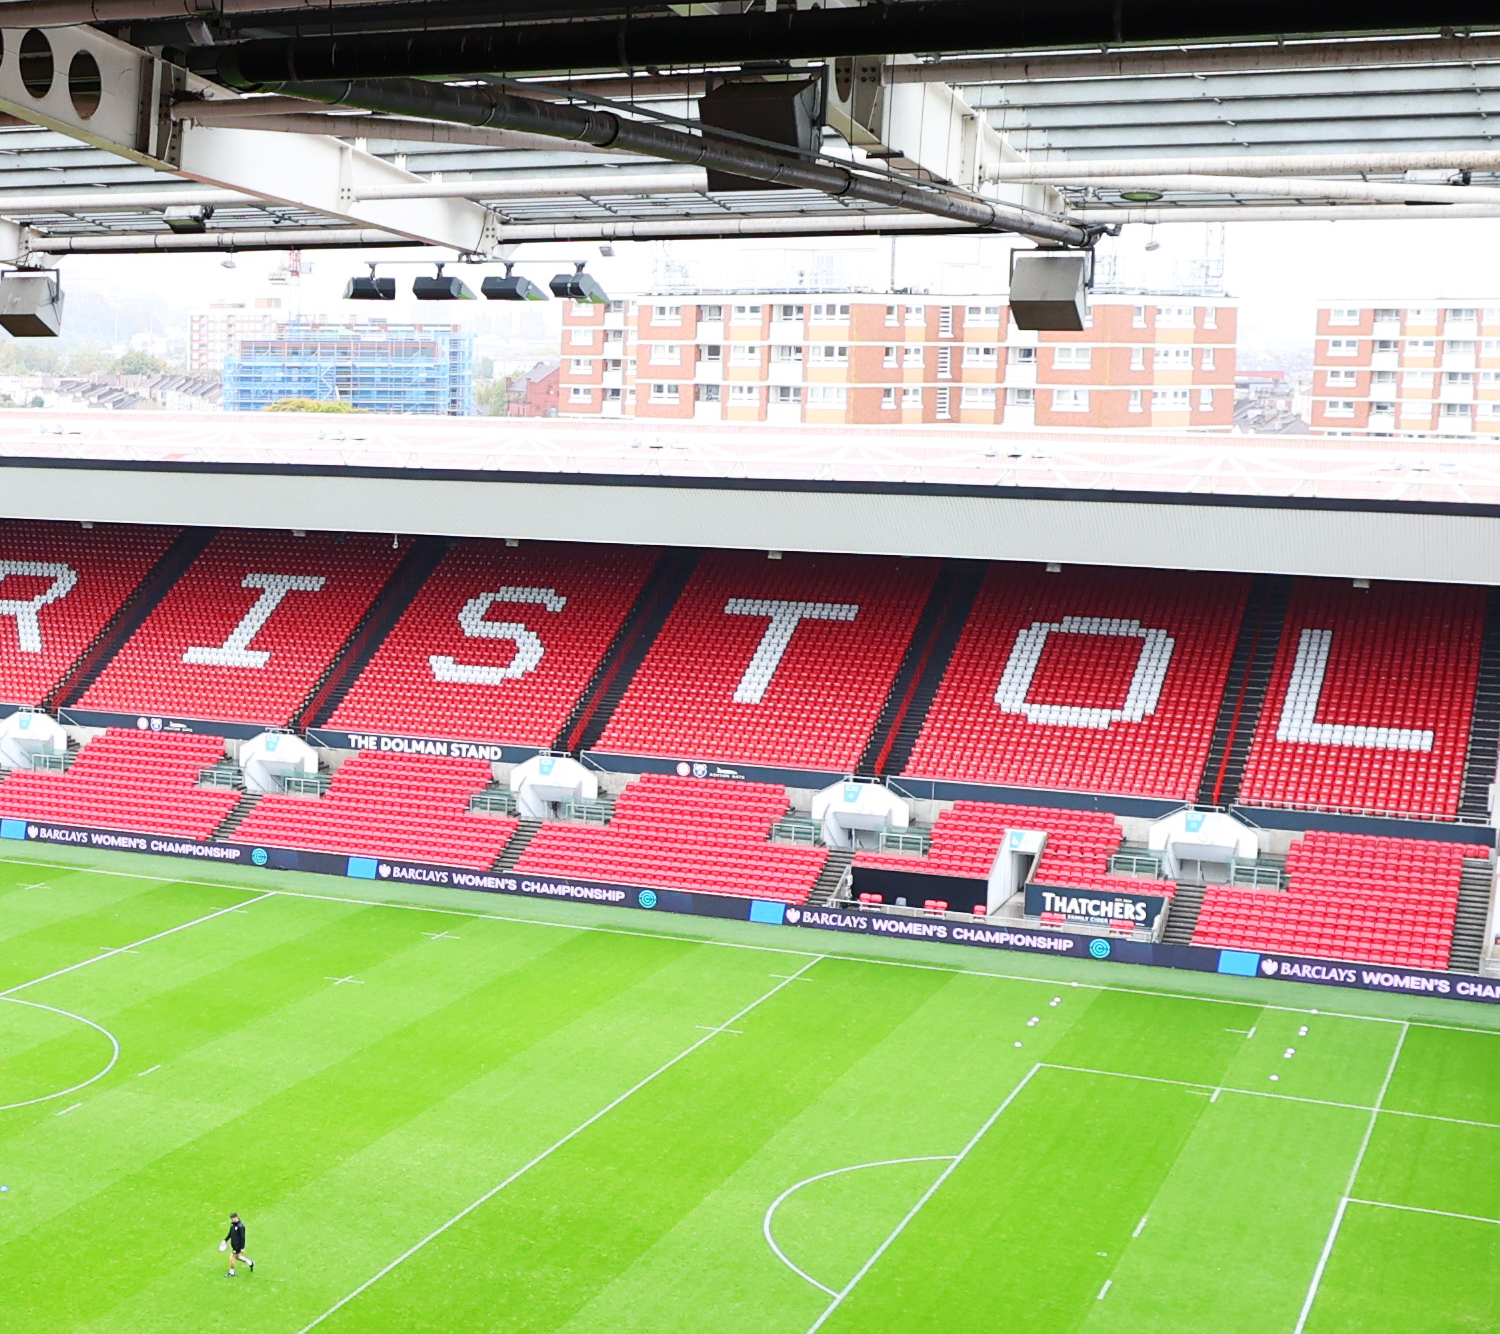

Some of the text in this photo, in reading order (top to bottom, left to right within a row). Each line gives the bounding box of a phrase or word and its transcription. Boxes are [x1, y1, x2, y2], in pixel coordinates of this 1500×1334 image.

[348, 734, 502, 760] THE DOLMAN STAND
[39, 827, 241, 860] BARCLAYS WOMEN'S CHAMPIONSHIP
[392, 866, 626, 902] BARCLAYS WOMEN'S CHAMPIONSHIP
[1042, 892, 1147, 921] THATCHERS
[1067, 914, 1089, 922] FAMILY
[802, 911, 1074, 951] BARCLAYS WOMEN'S CHAMPIONSHIP
[1280, 962, 1357, 983] BARCLAYS
[1361, 970, 1450, 994] WOMEN'S
